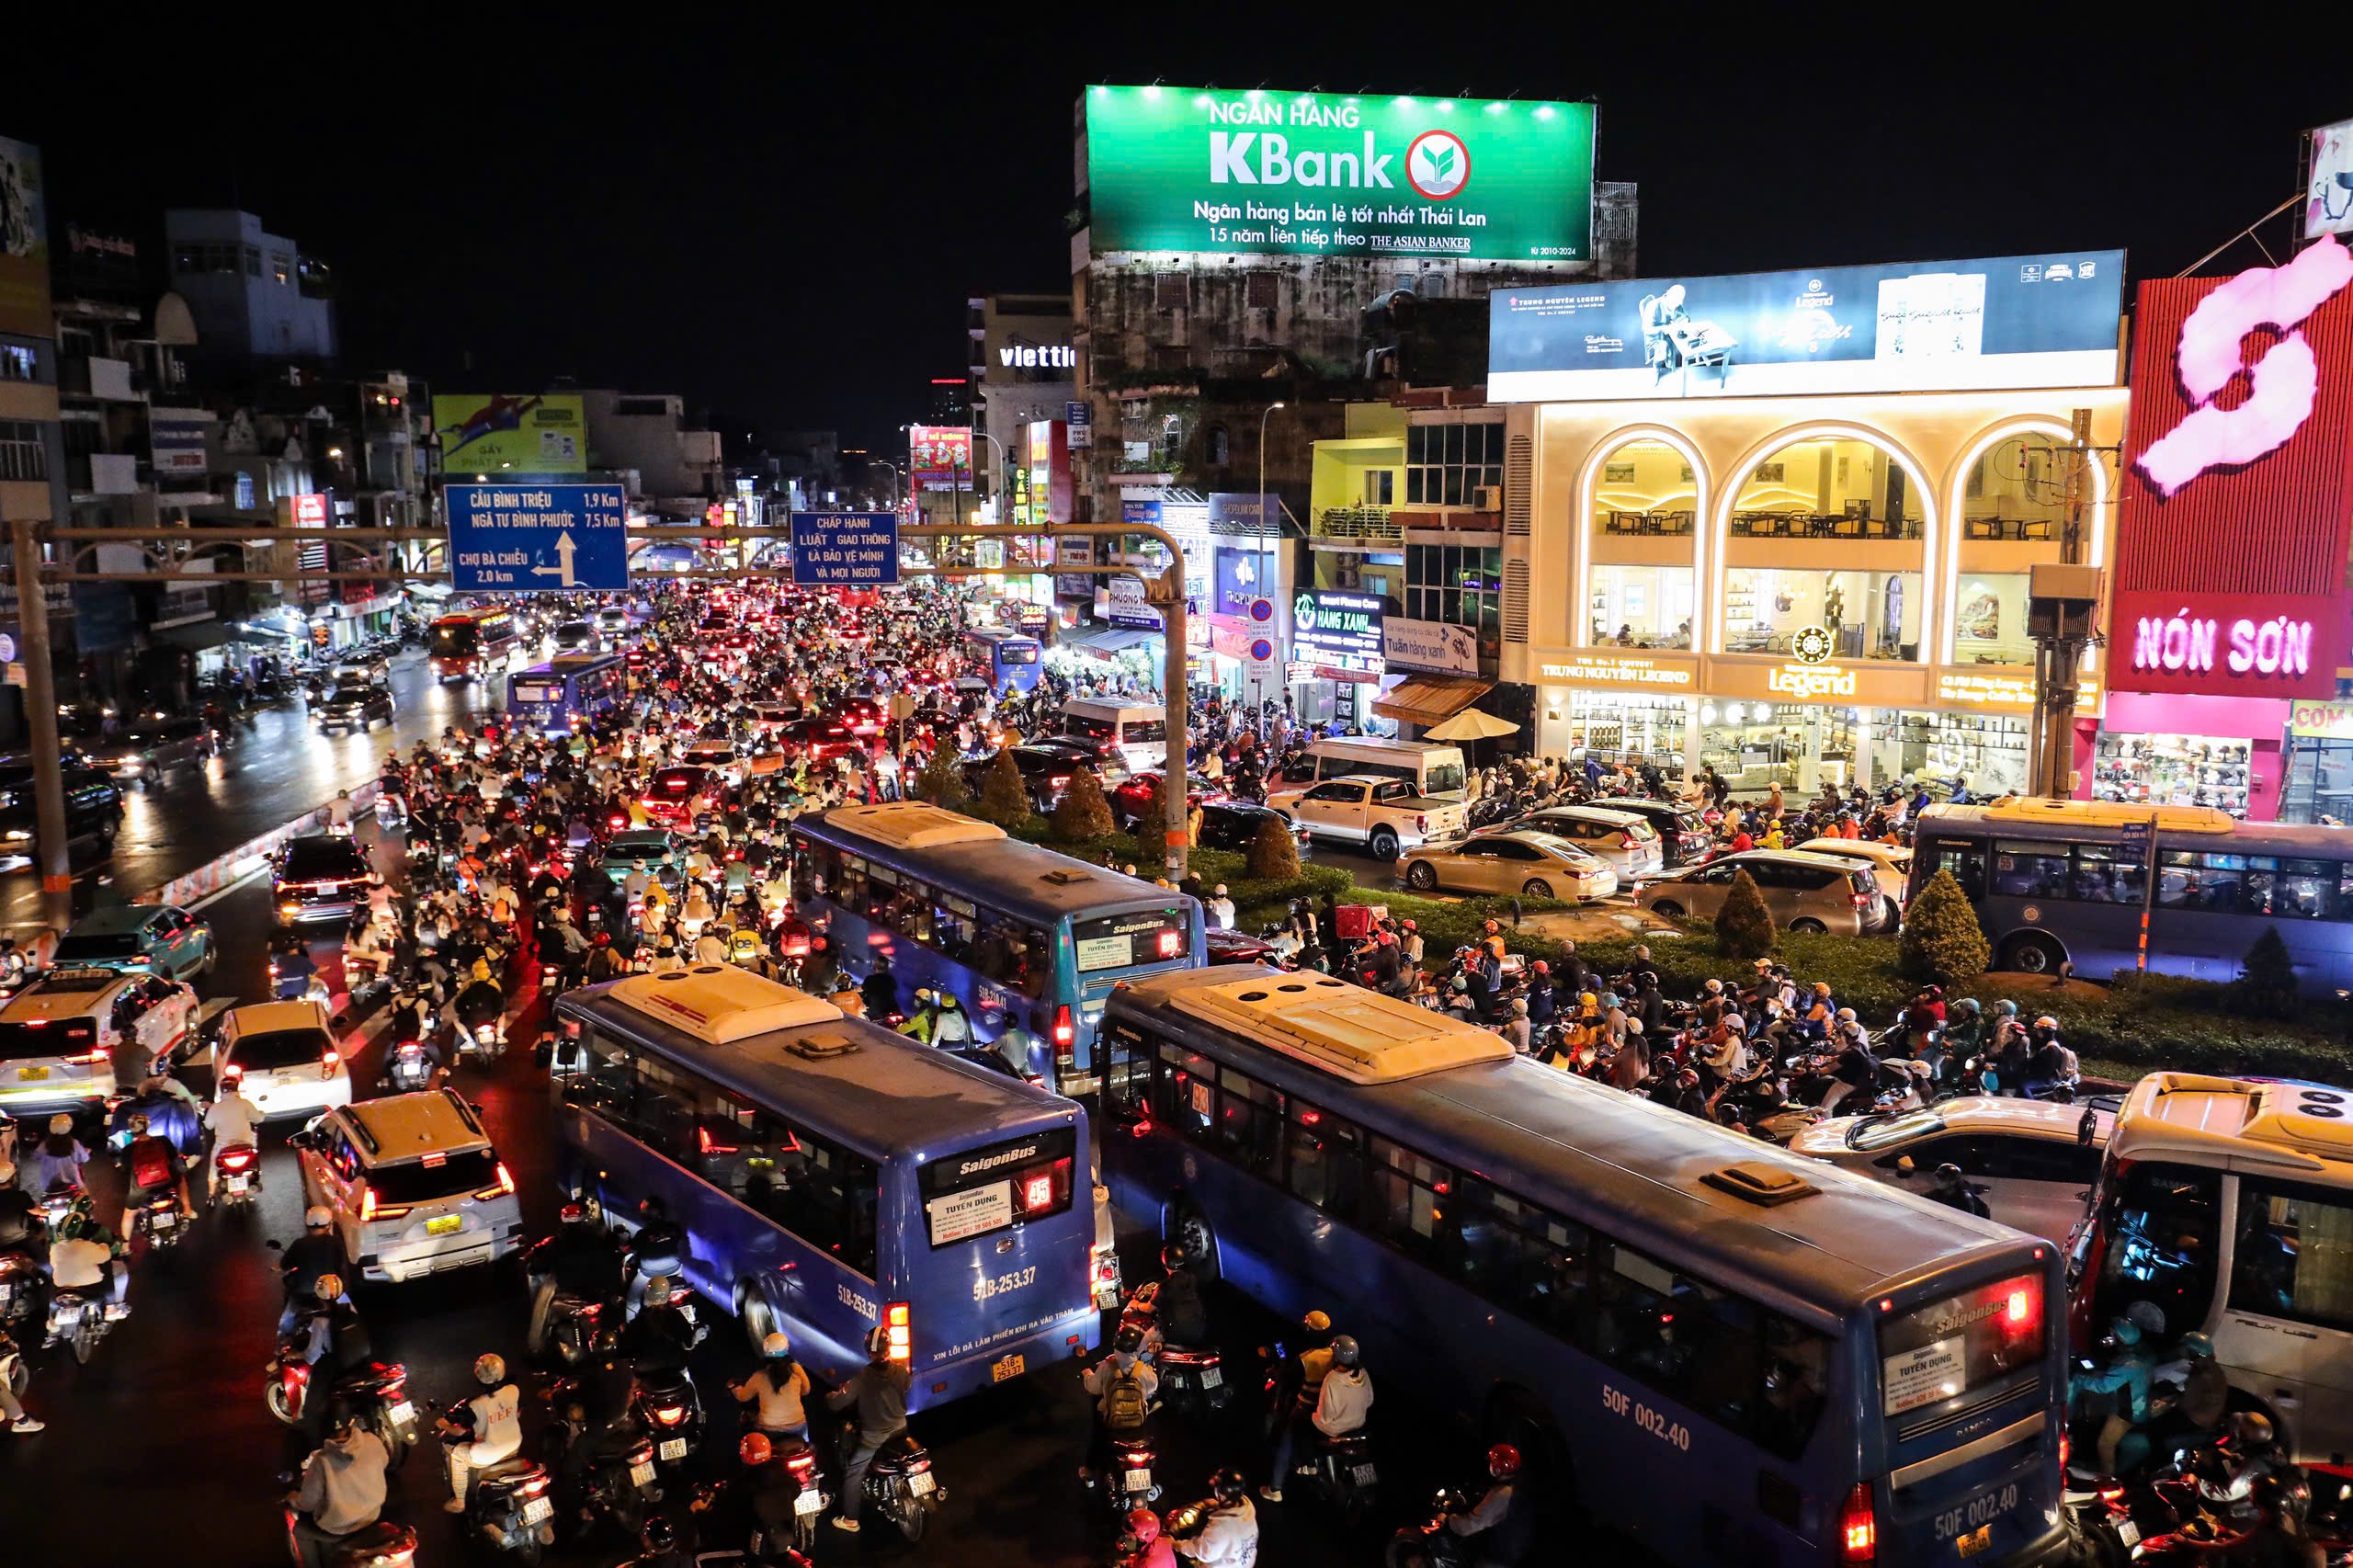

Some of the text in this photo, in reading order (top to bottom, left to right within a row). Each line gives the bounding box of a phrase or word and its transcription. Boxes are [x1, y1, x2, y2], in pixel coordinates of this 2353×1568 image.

[1290, 97, 1360, 129] HÀNG
[1210, 131, 1393, 188] KBank
[1195, 200, 1486, 226] Ngân hàng bán lẻ tốt nhất Thái Lan
[1211, 225, 1367, 249] 15 năm liên tiếp theo
[1370, 235, 1471, 249] THE ASIAN BANKER
[1540, 246, 1576, 256] 2010-2024
[470, 489, 619, 511] CẦU BÌNH TRIỆU 1.9 Km
[472, 510, 620, 528] NGÃ TƯ BÌNH PHƯỚC 7.5 Km
[817, 516, 870, 528] CHẤP HÀNH
[800, 533, 891, 547] LUẬT GIAO THÔNG
[459, 552, 479, 568] CHỢ
[482, 551, 496, 566] BÀ
[808, 549, 821, 562] LÀ
[824, 549, 842, 562] BẢO
[859, 549, 884, 562] MÌNH
[477, 570, 514, 584] 2.0 km
[816, 564, 881, 580] VÀ MỌI NGƯỜI
[1317, 608, 1341, 629] HÀNG
[1343, 613, 1369, 632] XANH
[1387, 637, 1408, 654] Tuấn
[1409, 641, 1427, 659] hàng
[1428, 643, 1446, 659] xanh
[2135, 607, 2313, 675] NÓN SƠN
[1541, 664, 1690, 684] TRUNG NGUYÊN LEGEND
[1768, 668, 1856, 698] Legend
[2295, 704, 2345, 729] CƠM
[2154, 767, 2192, 775] SCHOOL
[1428, 821, 1461, 832] RANGER
[1998, 855, 2013, 868] 55
[1113, 919, 1165, 934] SaigonBus
[1160, 934, 1178, 952] 93
[1195, 1085, 1208, 1112] 93
[960, 1145, 1037, 1176] SaigonBus
[945, 1194, 997, 1214] TUYỂN DỤNG
[1029, 1181, 1050, 1205] 45
[972, 1266, 1037, 1302] 51B-253.37
[837, 1283, 877, 1322] 51B-253.37
[1936, 1299, 2009, 1334] SaigonBus
[933, 1351, 947, 1361] XIN
[949, 1345, 961, 1357] LỖI
[962, 1343, 973, 1353] ĐÃ
[975, 1337, 991, 1347] LÀM
[1015, 1324, 1028, 1335] KHI
[1029, 1320, 1039, 1330] RA
[1040, 1315, 1053, 1325] VÀO
[1055, 1308, 1074, 1320] TRẠM
[997, 1364, 1022, 1381] 253.37
[1000, 1358, 1016, 1370] 51B
[1899, 1353, 1952, 1377] TUYỂN DỤNG
[1603, 1384, 1689, 1452] 50F 002.40
[1935, 1483, 2018, 1540] 50F 002.40
